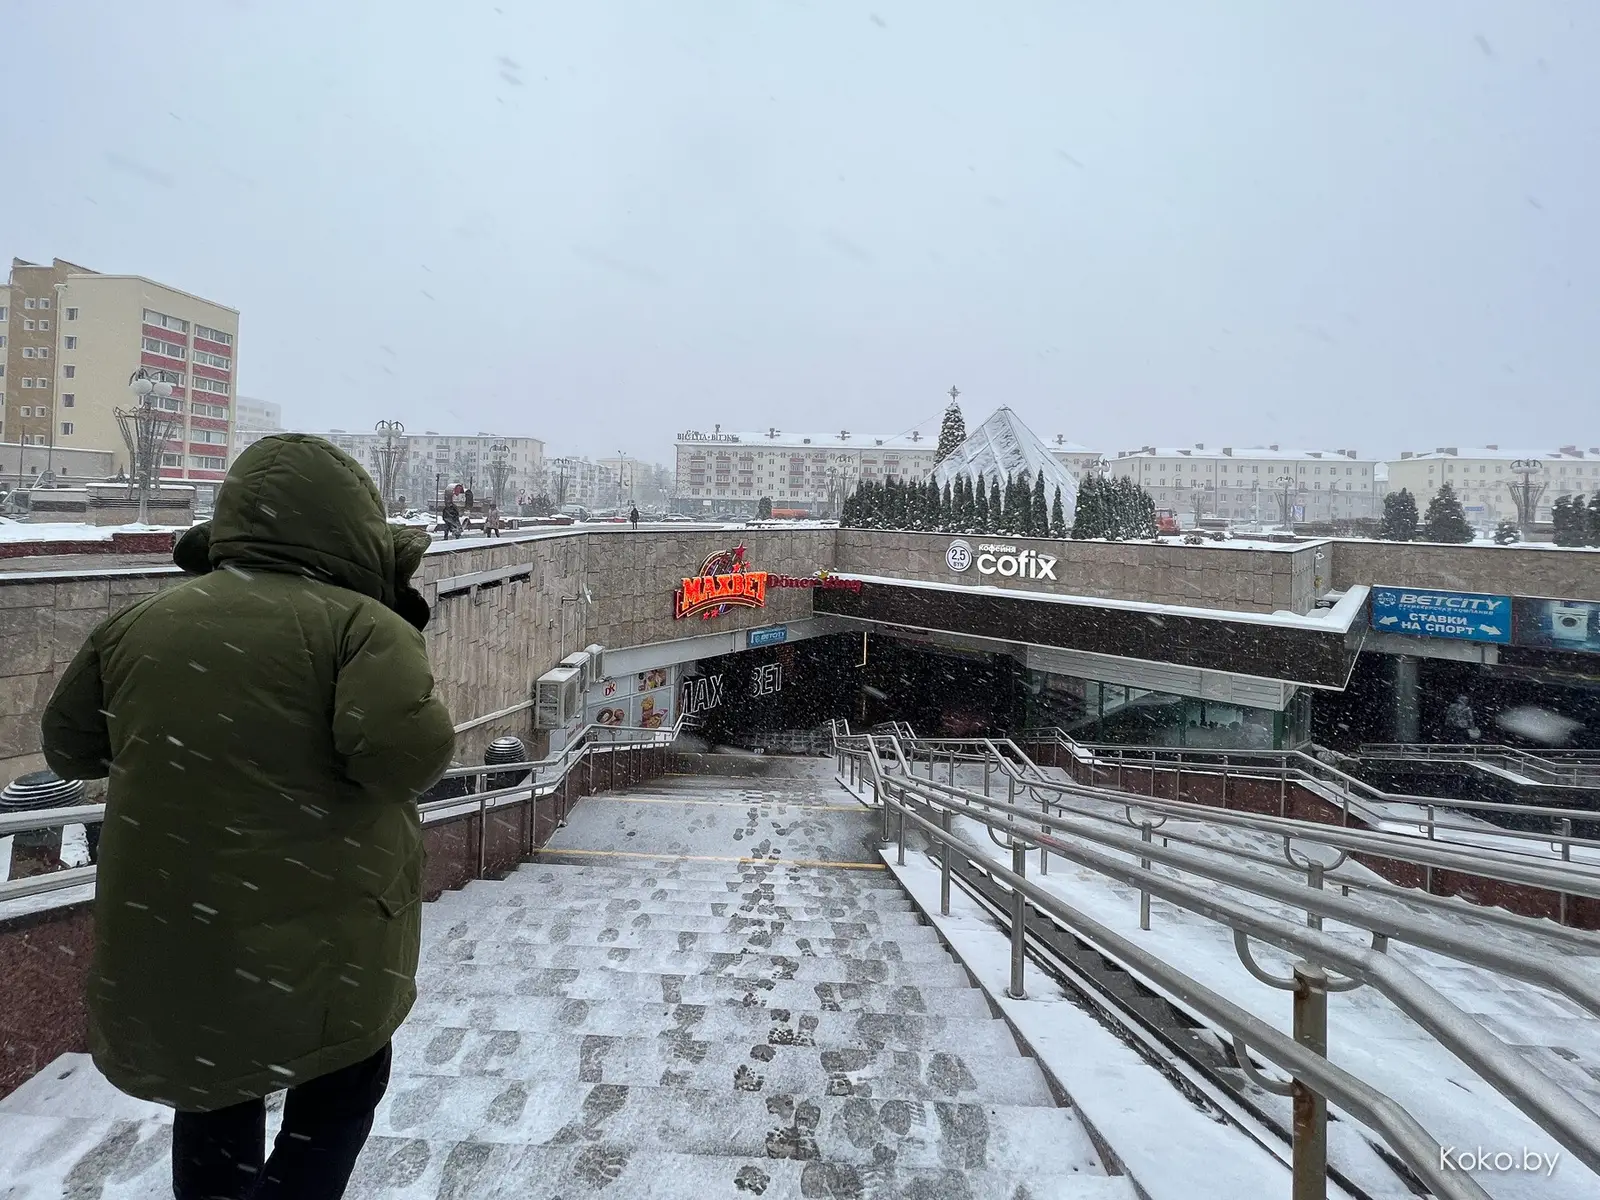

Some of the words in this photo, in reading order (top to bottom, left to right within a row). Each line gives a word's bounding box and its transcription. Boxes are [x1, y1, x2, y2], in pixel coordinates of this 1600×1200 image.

[951, 549, 966, 561] 2,5
[977, 550, 1057, 580] cofix
[682, 571, 768, 610] MAXBET
[1400, 593, 1502, 610] BETCITY
[1409, 613, 1468, 625] СТАВКИ
[1401, 621, 1421, 630] НА
[1425, 623, 1475, 635] СПОРТ
